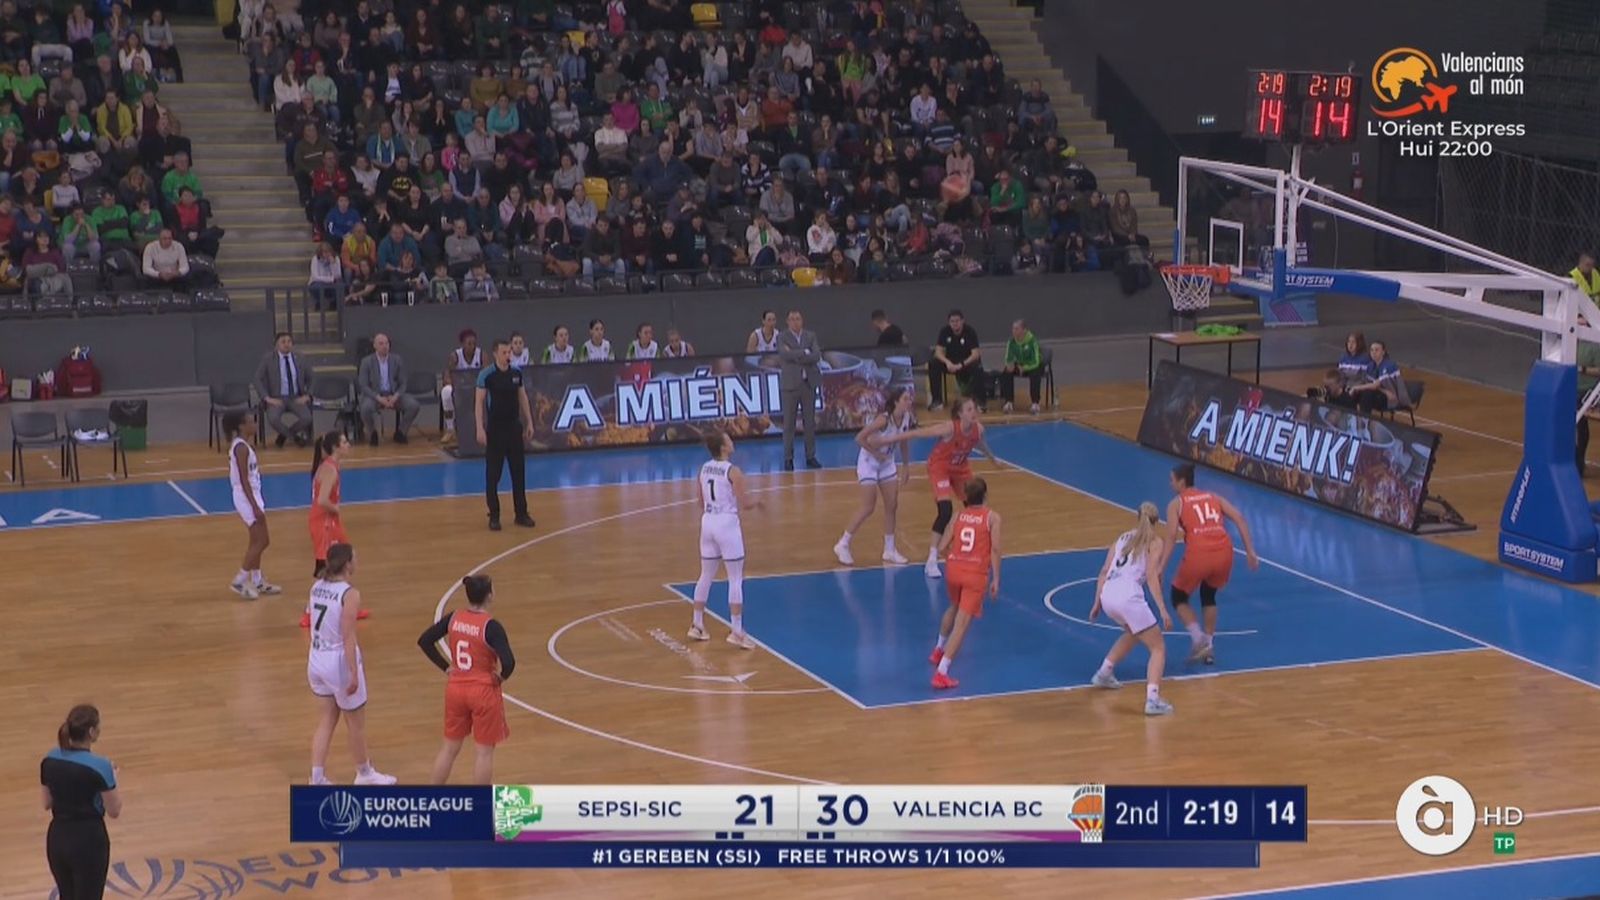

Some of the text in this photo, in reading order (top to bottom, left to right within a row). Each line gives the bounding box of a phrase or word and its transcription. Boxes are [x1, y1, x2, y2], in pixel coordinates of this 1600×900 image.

[1258, 72, 1284, 94] 2:19
[1309, 75, 1351, 97] 2:19
[1259, 99, 1281, 134] 14
[1314, 101, 1350, 137] 14
[554, 385, 604, 431] A
[1190, 399, 1362, 485] A MIÉNK!
[706, 479, 716, 502] 1
[1192, 501, 1220, 525] 14
[960, 527, 976, 552] 9
[313, 603, 328, 632] 7
[456, 640, 473, 671] 6
